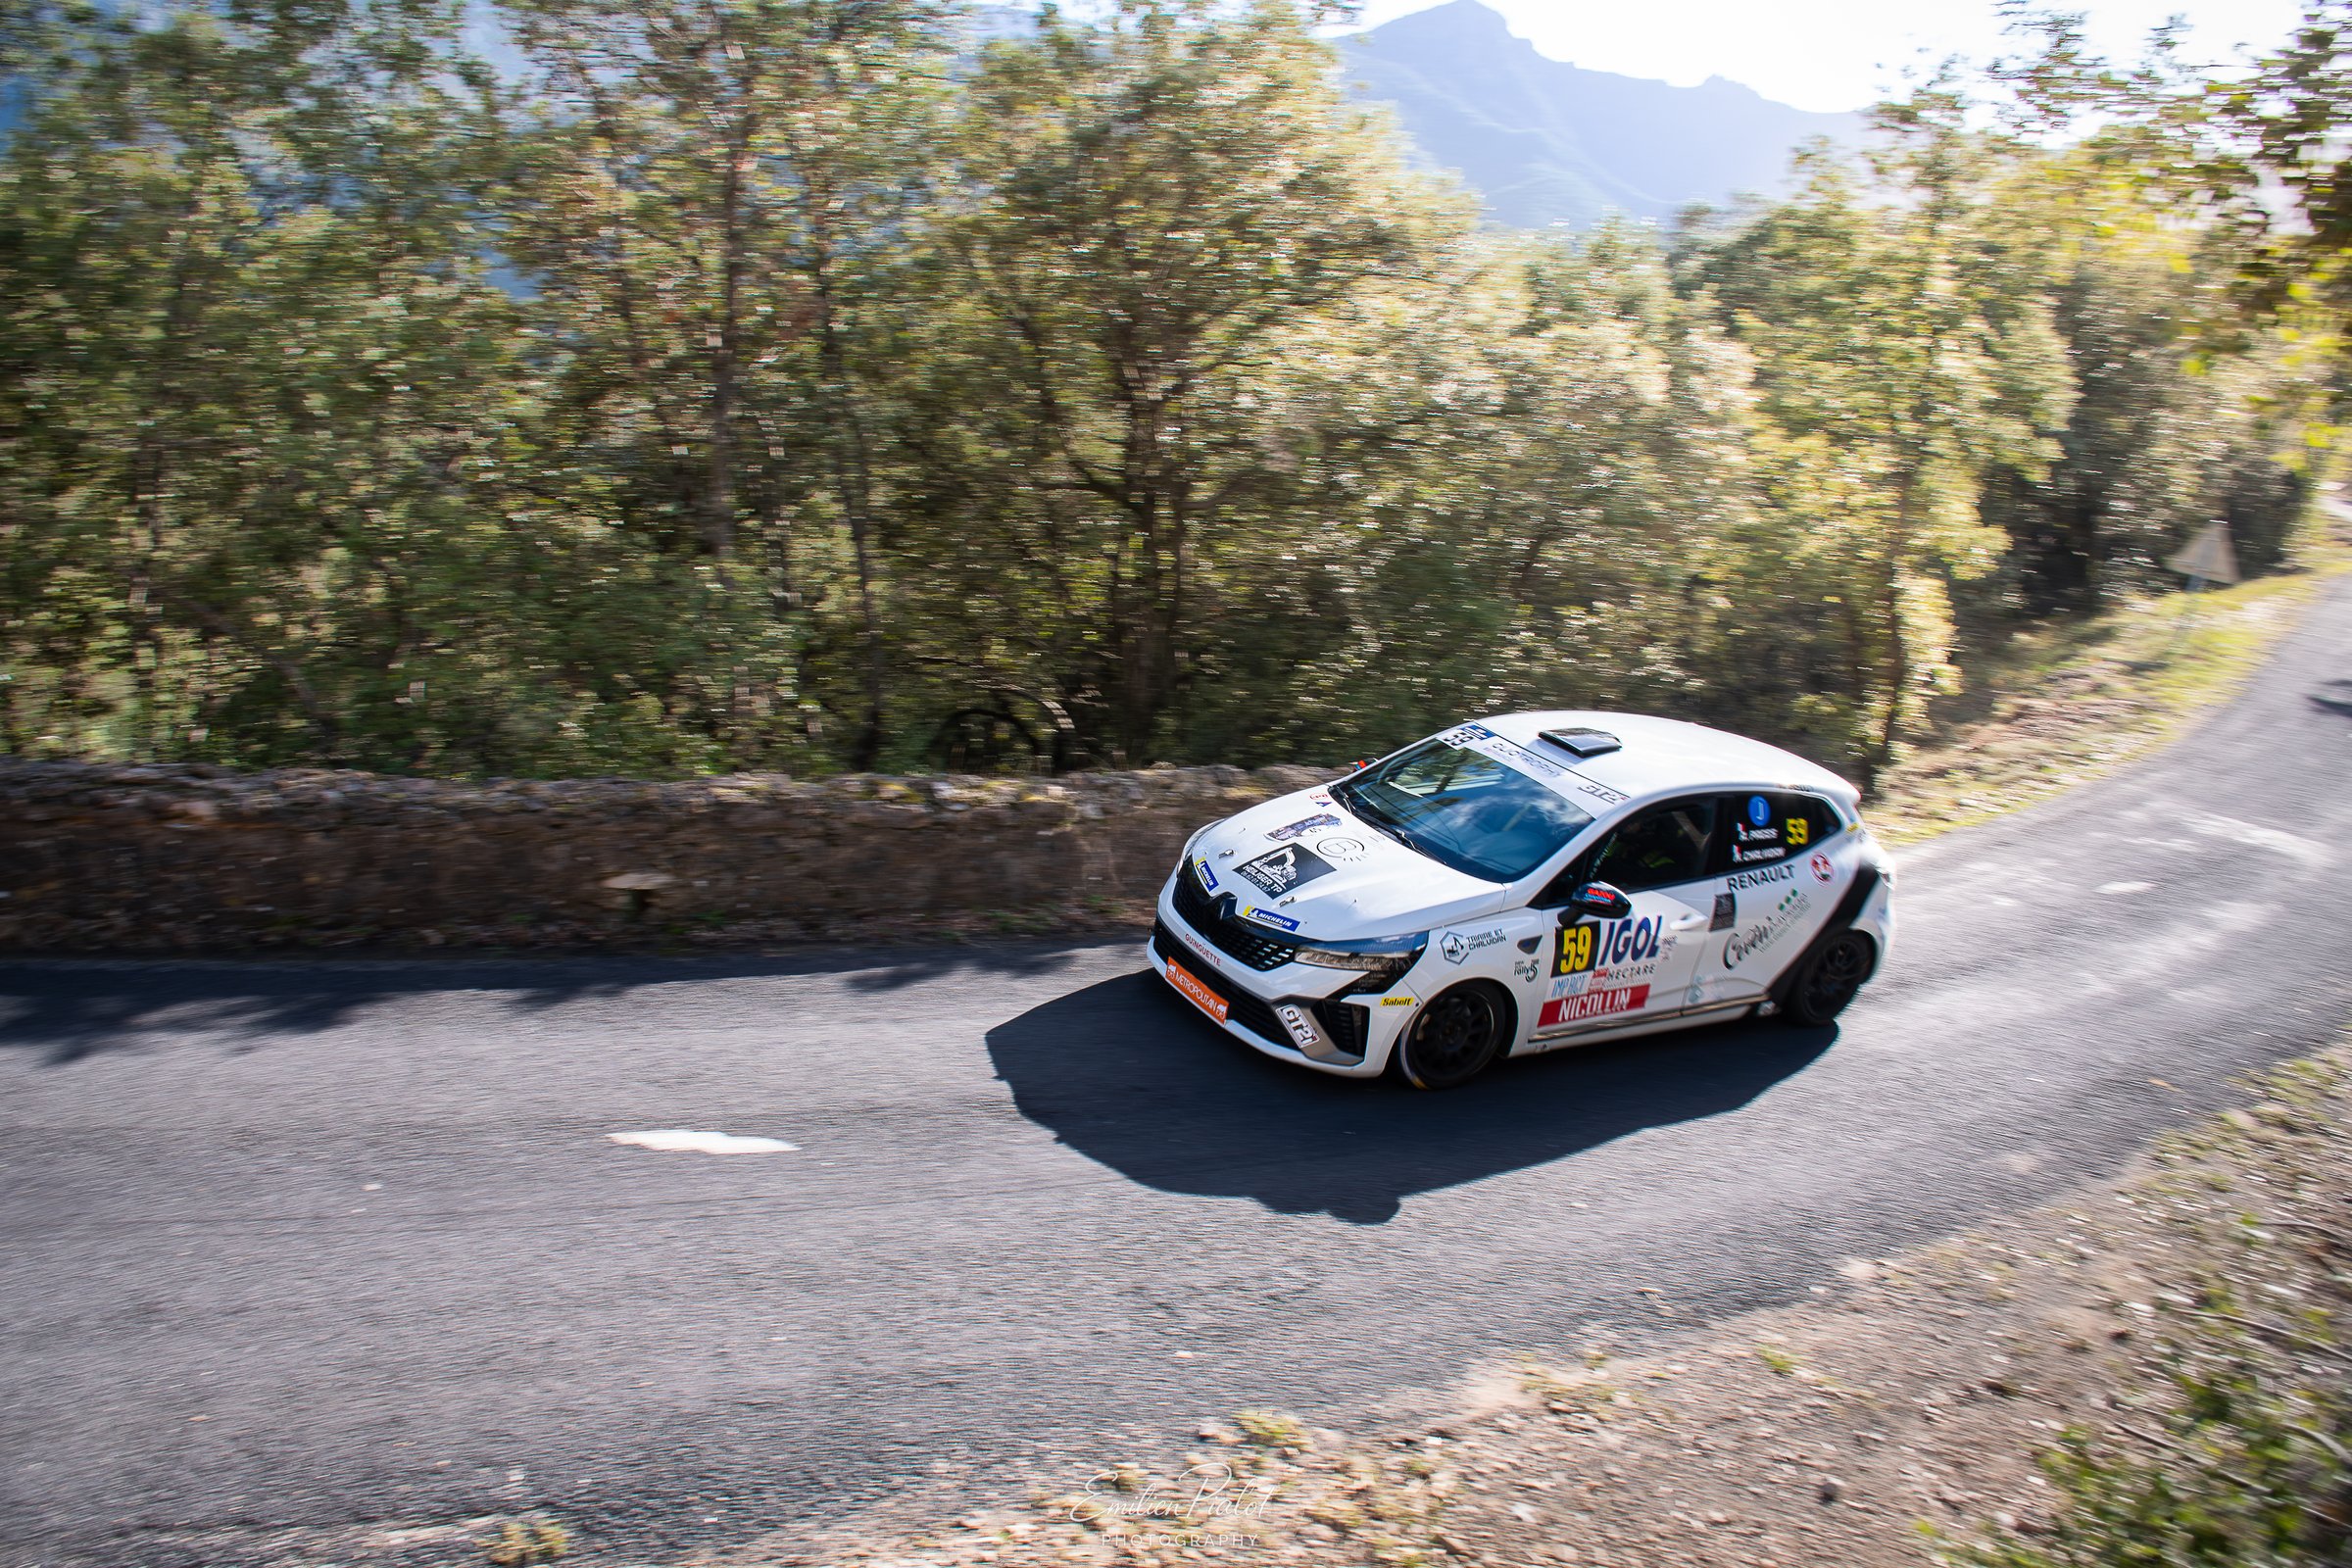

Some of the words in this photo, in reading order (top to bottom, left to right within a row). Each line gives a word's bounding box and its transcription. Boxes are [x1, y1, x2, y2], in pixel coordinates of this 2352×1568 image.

[1786, 817, 1810, 846] 59
[1270, 883, 1283, 893] TP
[1727, 863, 1795, 892] RENAULT
[1258, 911, 1293, 927] MICHELIN
[1185, 933, 1221, 966] GUINGUETTE
[1559, 925, 1592, 974] 59
[1598, 915, 1663, 966] IGOL
[1175, 971, 1218, 1012] METROPOLITAN
[1558, 988, 1632, 1021] NICOLLIN
